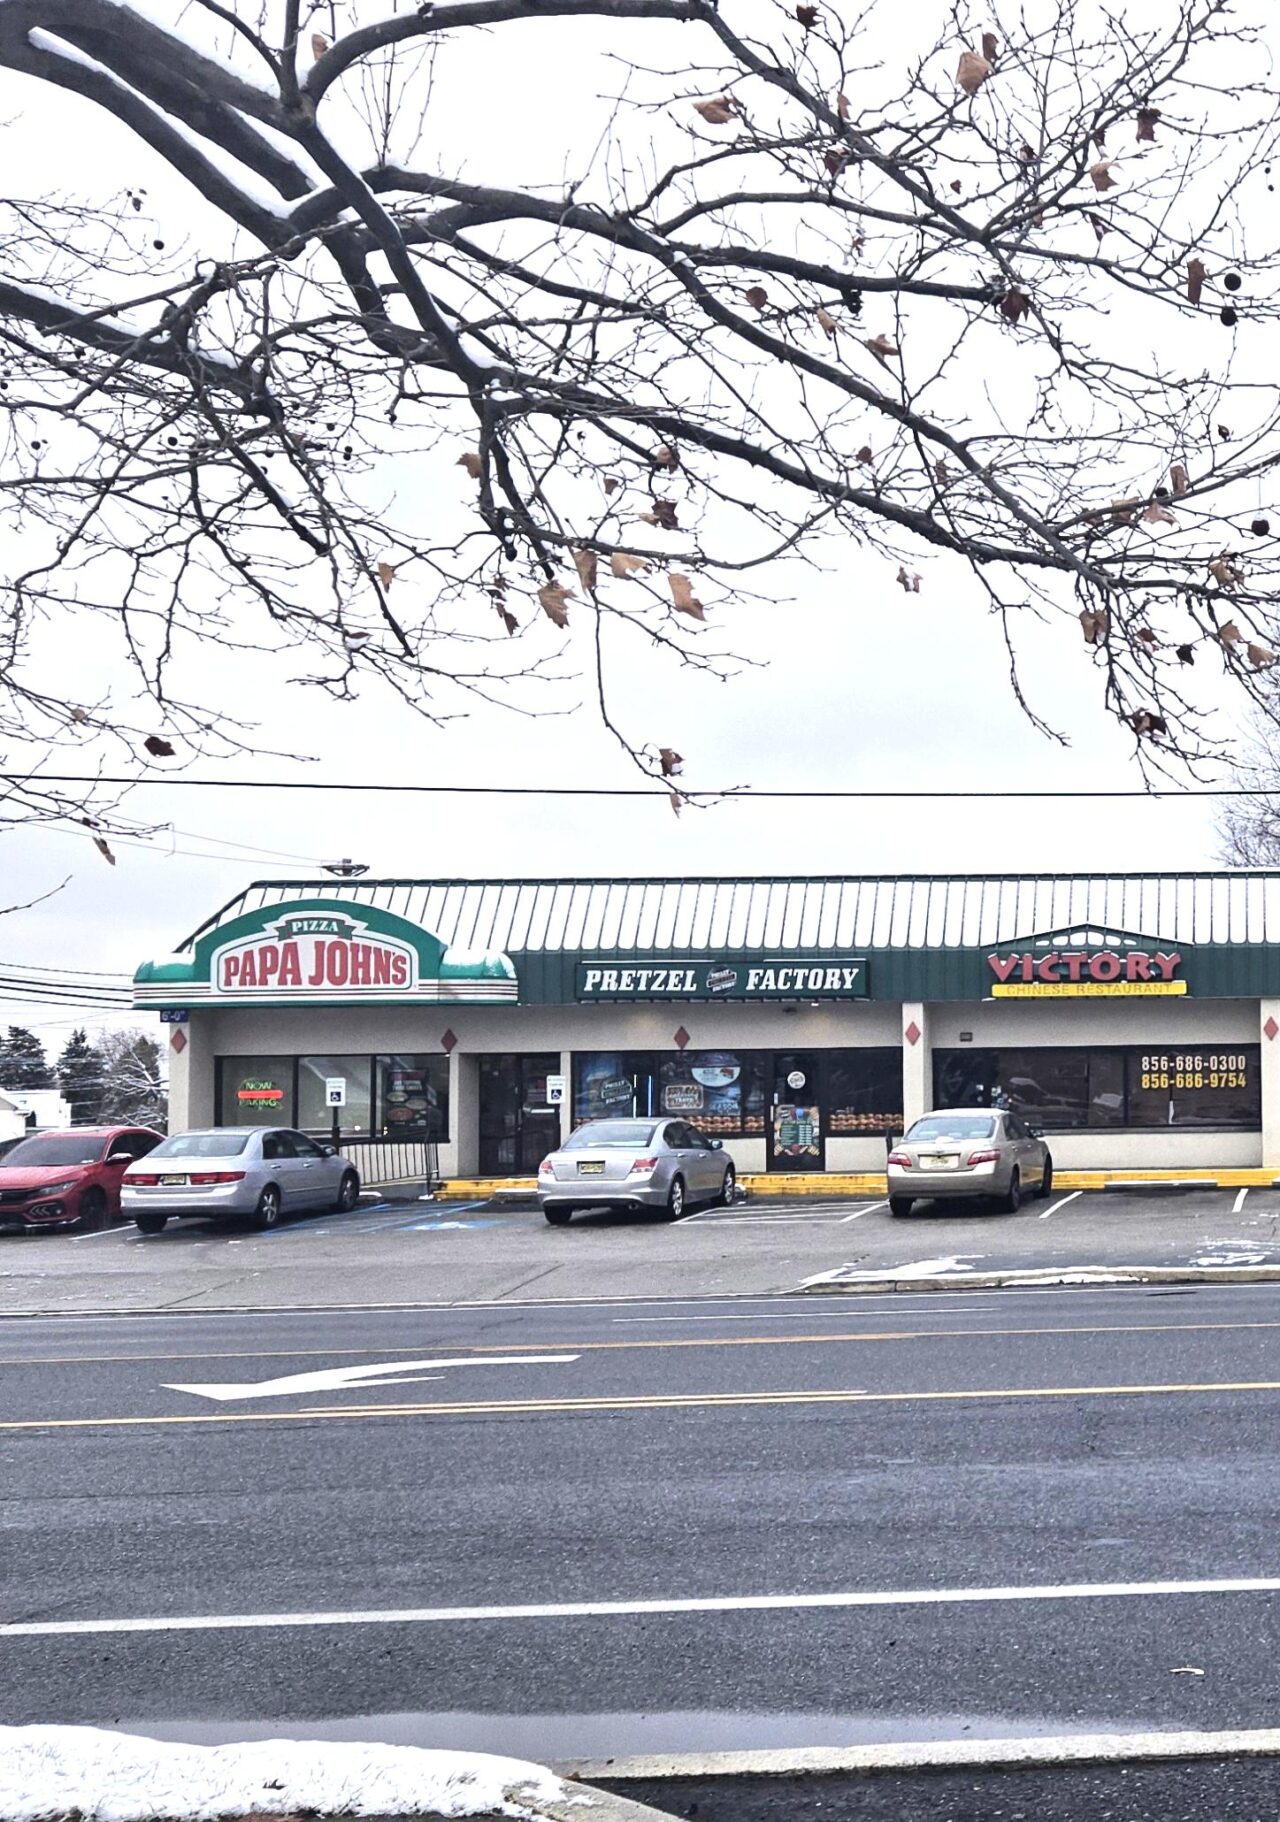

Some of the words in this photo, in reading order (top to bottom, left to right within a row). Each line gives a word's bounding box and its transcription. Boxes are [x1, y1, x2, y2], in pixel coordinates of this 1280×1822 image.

[291, 920, 340, 933] PIZZA
[223, 941, 303, 987] PAPA
[308, 940, 407, 987] JOHN'S
[987, 951, 1181, 982] VICTORY
[583, 970, 698, 992] PRETZEL
[745, 968, 860, 991] FACTORY
[1006, 983, 1069, 995] CHINESE
[1076, 983, 1172, 994] RESTAURANT
[1141, 1055, 1246, 1071] 856-686-0300
[245, 1081, 273, 1090] NOW
[1141, 1073, 1246, 1089] 856-686-9754
